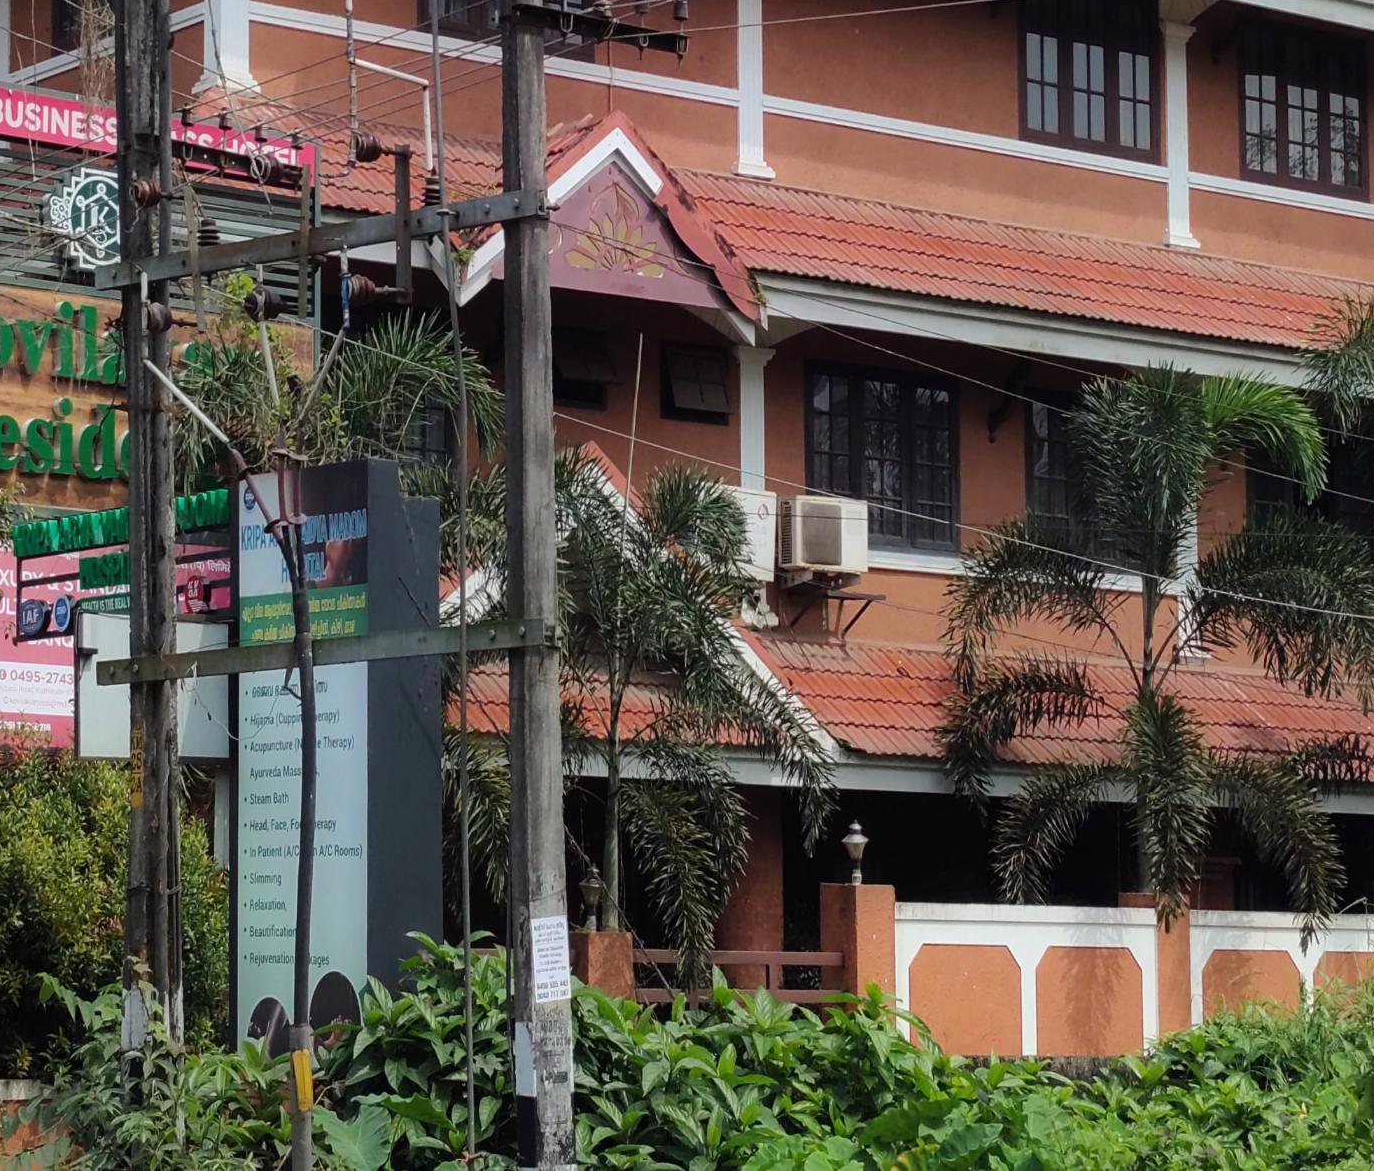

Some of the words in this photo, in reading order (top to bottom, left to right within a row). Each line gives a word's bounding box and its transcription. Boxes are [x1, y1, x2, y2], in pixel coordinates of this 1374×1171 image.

[241, 524, 266, 551] KRIPA
[329, 508, 368, 542] MADOM
[22, 608, 40, 625] IAF
[10, 669, 74, 685] 0495-2743
[250, 714, 275, 728] Hijama
[276, 713, 302, 728] (Cuppin
[315, 709, 340, 724] erapy)
[250, 739, 294, 754] Acupuncture
[323, 735, 355, 750] Therapy)
[250, 766, 281, 781] Ayurveda
[250, 793, 272, 805] Steam
[273, 791, 289, 804] Bath
[250, 819, 269, 831] Head,
[271, 819, 289, 833] Face,
[314, 818, 337, 833] erapy
[250, 848, 256, 858] In
[257, 846, 282, 858] Patient
[318, 844, 332, 857] A/C
[334, 844, 363, 859] Rooms)
[250, 872, 282, 886] Slimming
[250, 898, 287, 912] Relaxation,
[250, 952, 294, 967] Rejuvenation
[309, 954, 330, 968] kages
